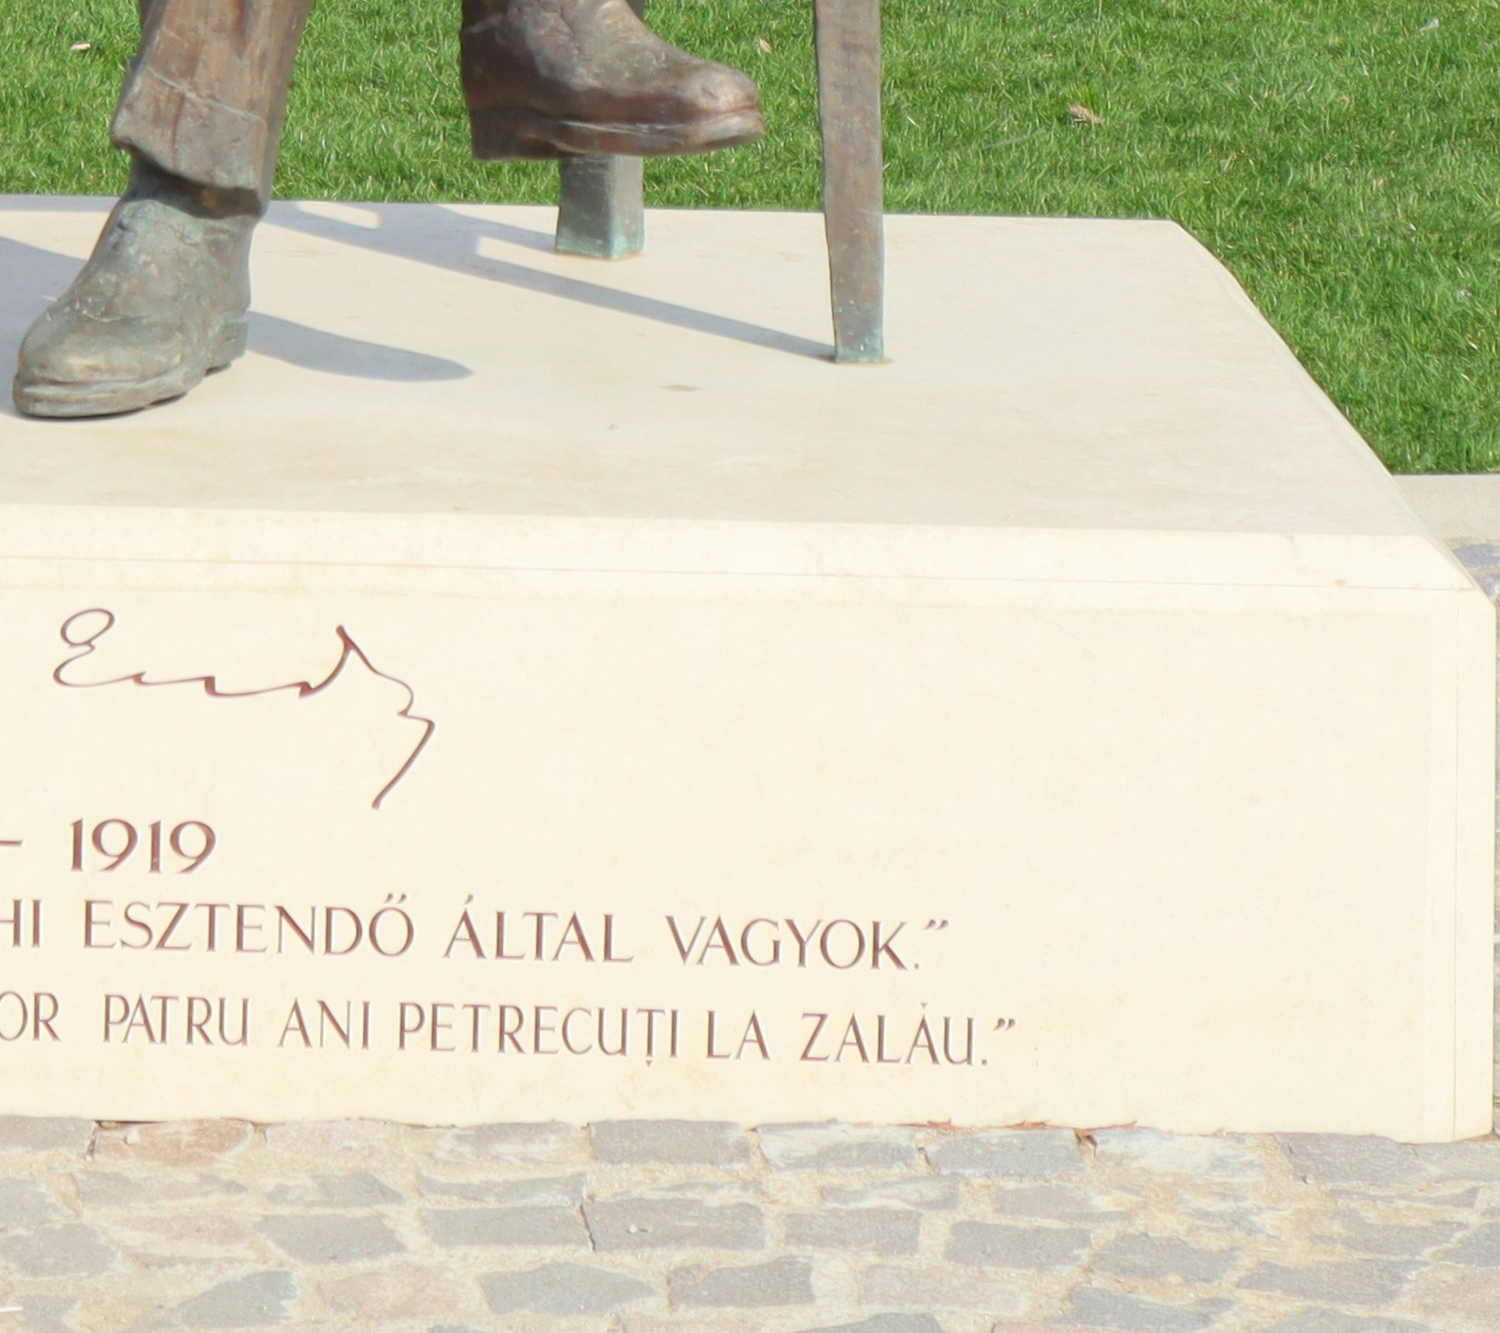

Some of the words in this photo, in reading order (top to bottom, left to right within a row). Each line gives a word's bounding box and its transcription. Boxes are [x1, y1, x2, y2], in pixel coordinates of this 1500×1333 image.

[69, 817, 218, 874] 1919
[83, 892, 416, 957] ESZTENDŐ
[443, 894, 634, 963] ÁLTAL
[103, 993, 249, 1046] PATRU
[278, 998, 370, 1050] ANI
[706, 1010, 770, 1061] LA
